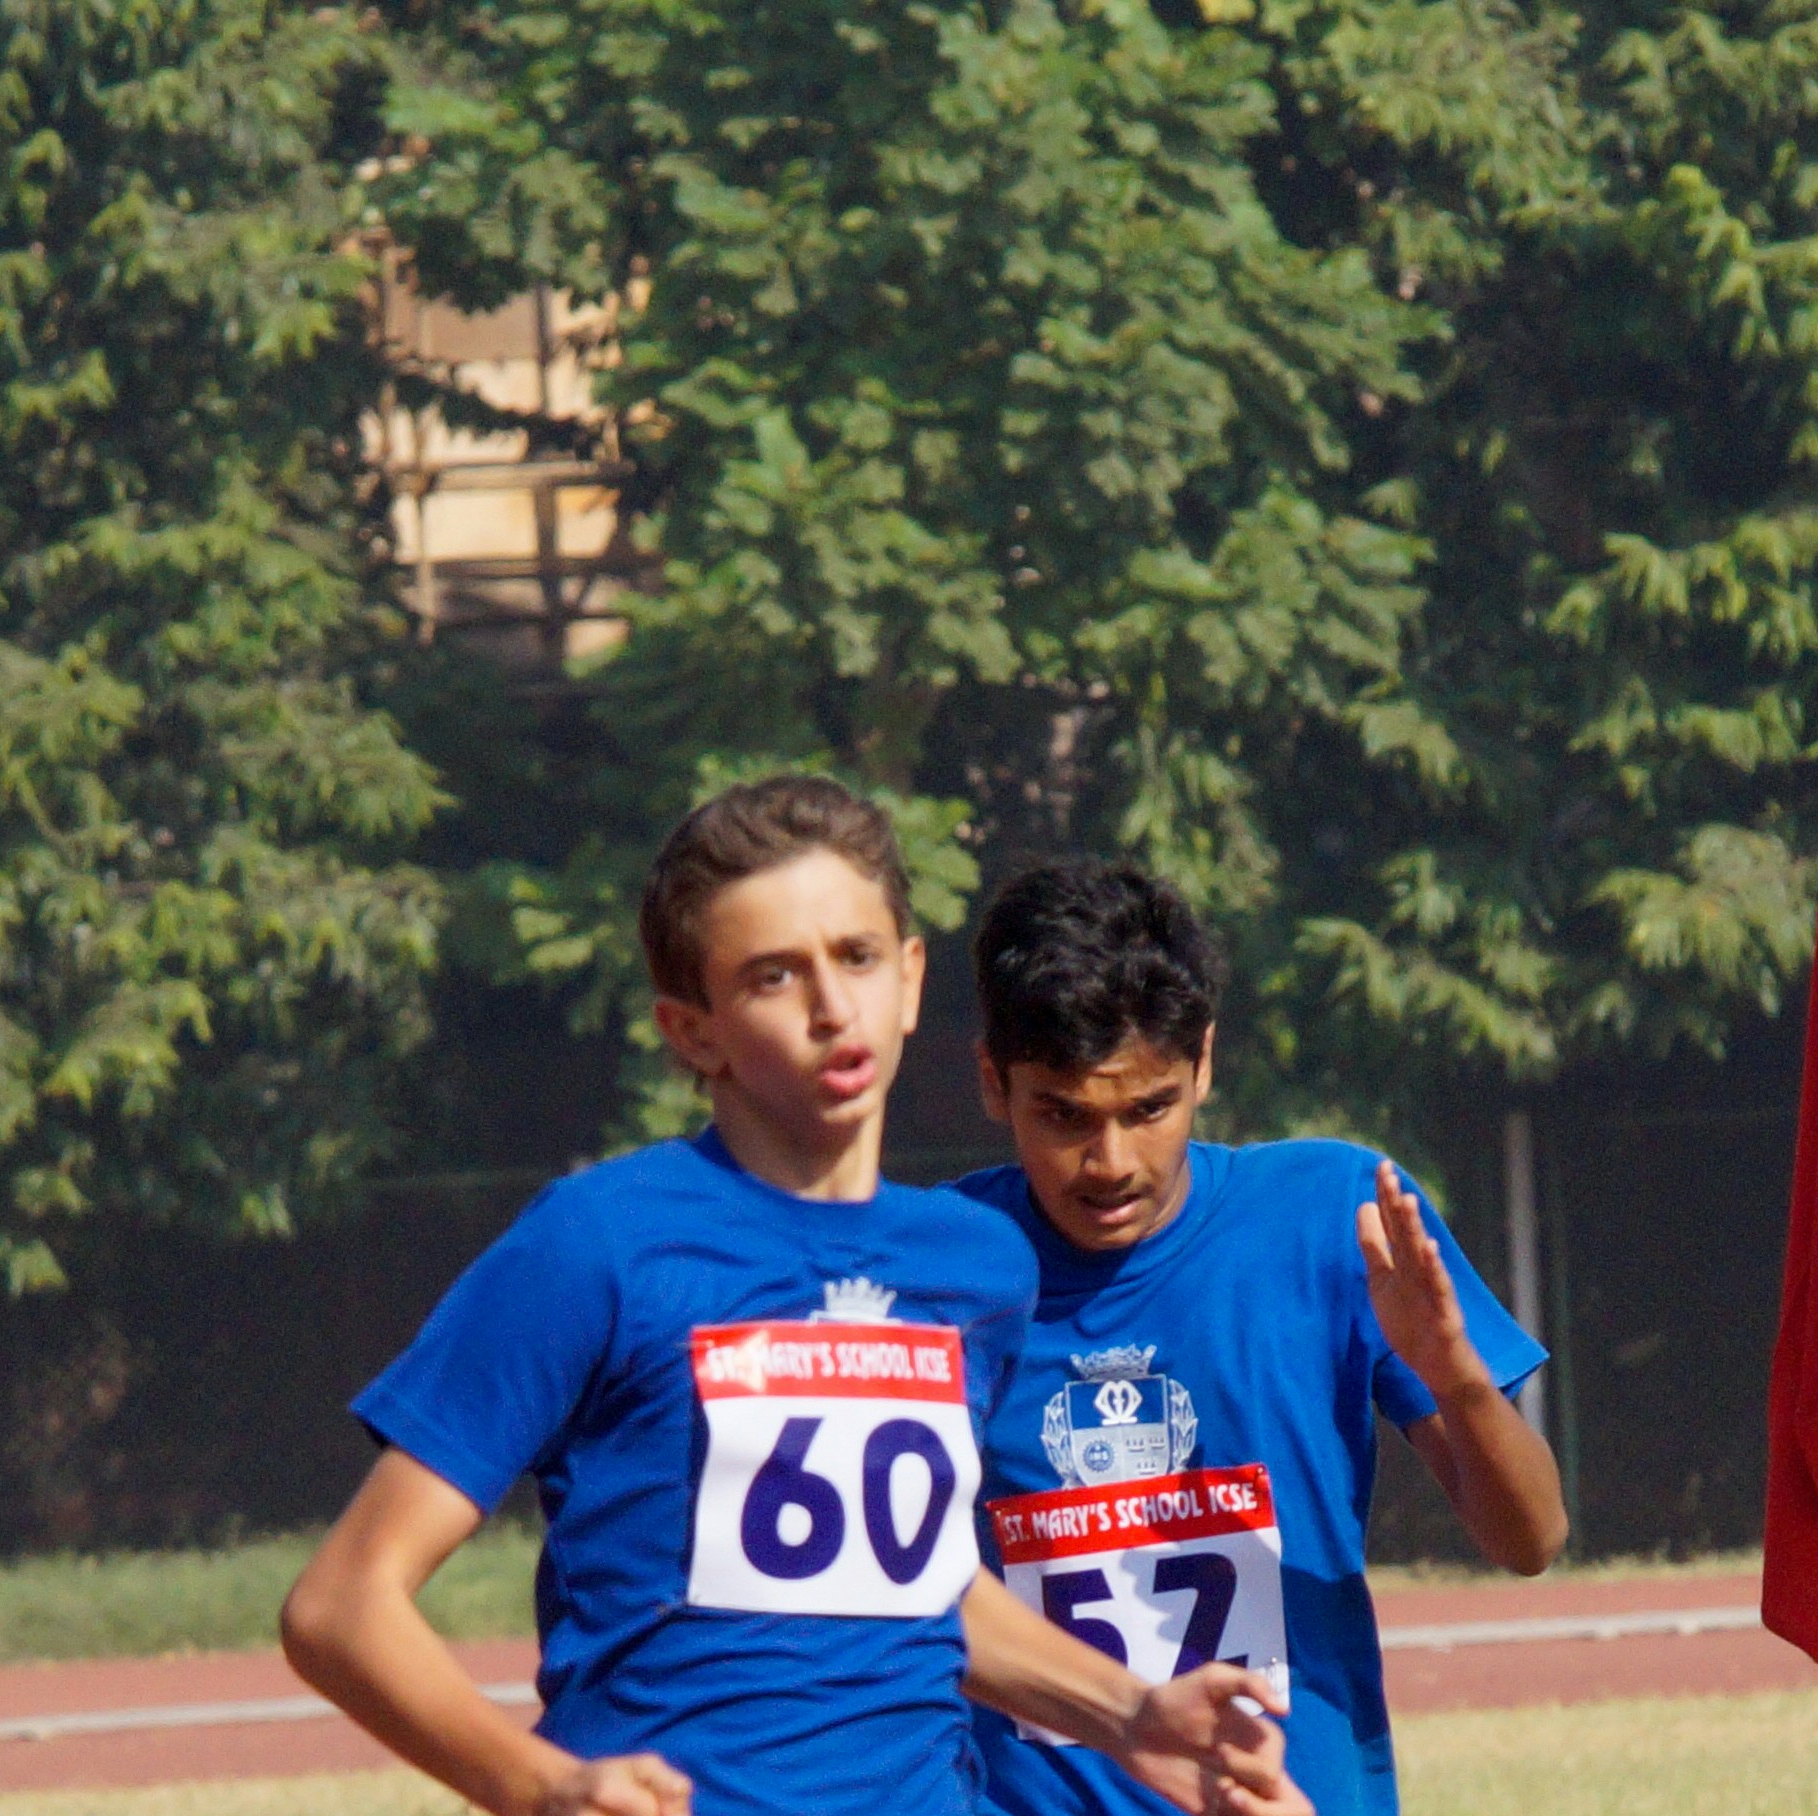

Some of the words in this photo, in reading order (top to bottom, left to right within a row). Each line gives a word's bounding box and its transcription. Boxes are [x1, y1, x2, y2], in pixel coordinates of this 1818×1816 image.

[836, 1342, 913, 1380] SCHOOL
[740, 1416, 956, 1586] 60
[1003, 1514, 1029, 1544] ST.
[1032, 1501, 1112, 1539] MARY'S
[1115, 1489, 1204, 1530] SCHOOL
[1209, 1482, 1258, 1514] ICSE
